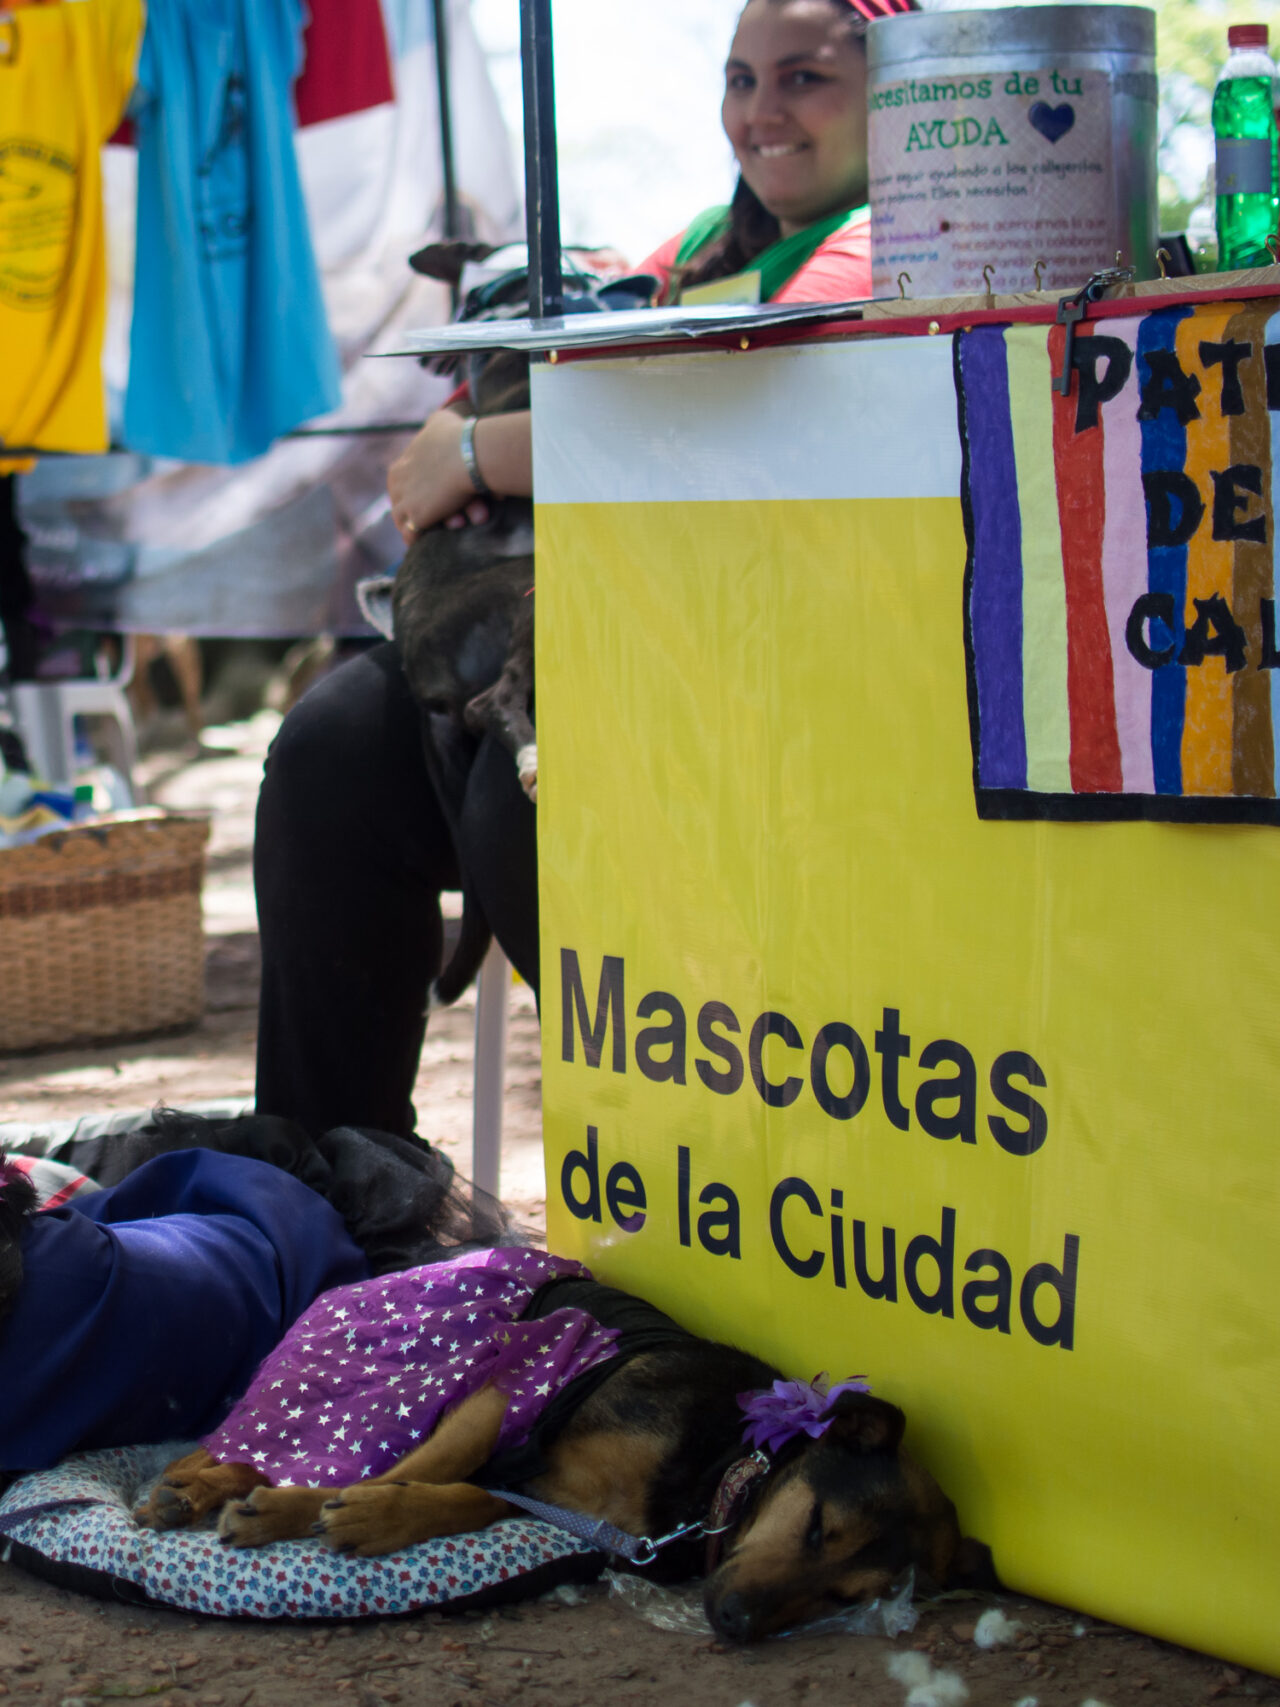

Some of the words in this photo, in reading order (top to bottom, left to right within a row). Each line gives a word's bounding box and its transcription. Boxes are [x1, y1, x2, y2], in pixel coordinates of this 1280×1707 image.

[1004, 70, 1040, 96] de
[1049, 68, 1084, 97] tu
[904, 116, 1010, 153] AYUDA
[1142, 464, 1267, 549] DE
[560, 946, 1048, 1157] Mascotas
[560, 1125, 647, 1234] de
[677, 1144, 742, 1260] la
[768, 1176, 1081, 1352] Ciudad
